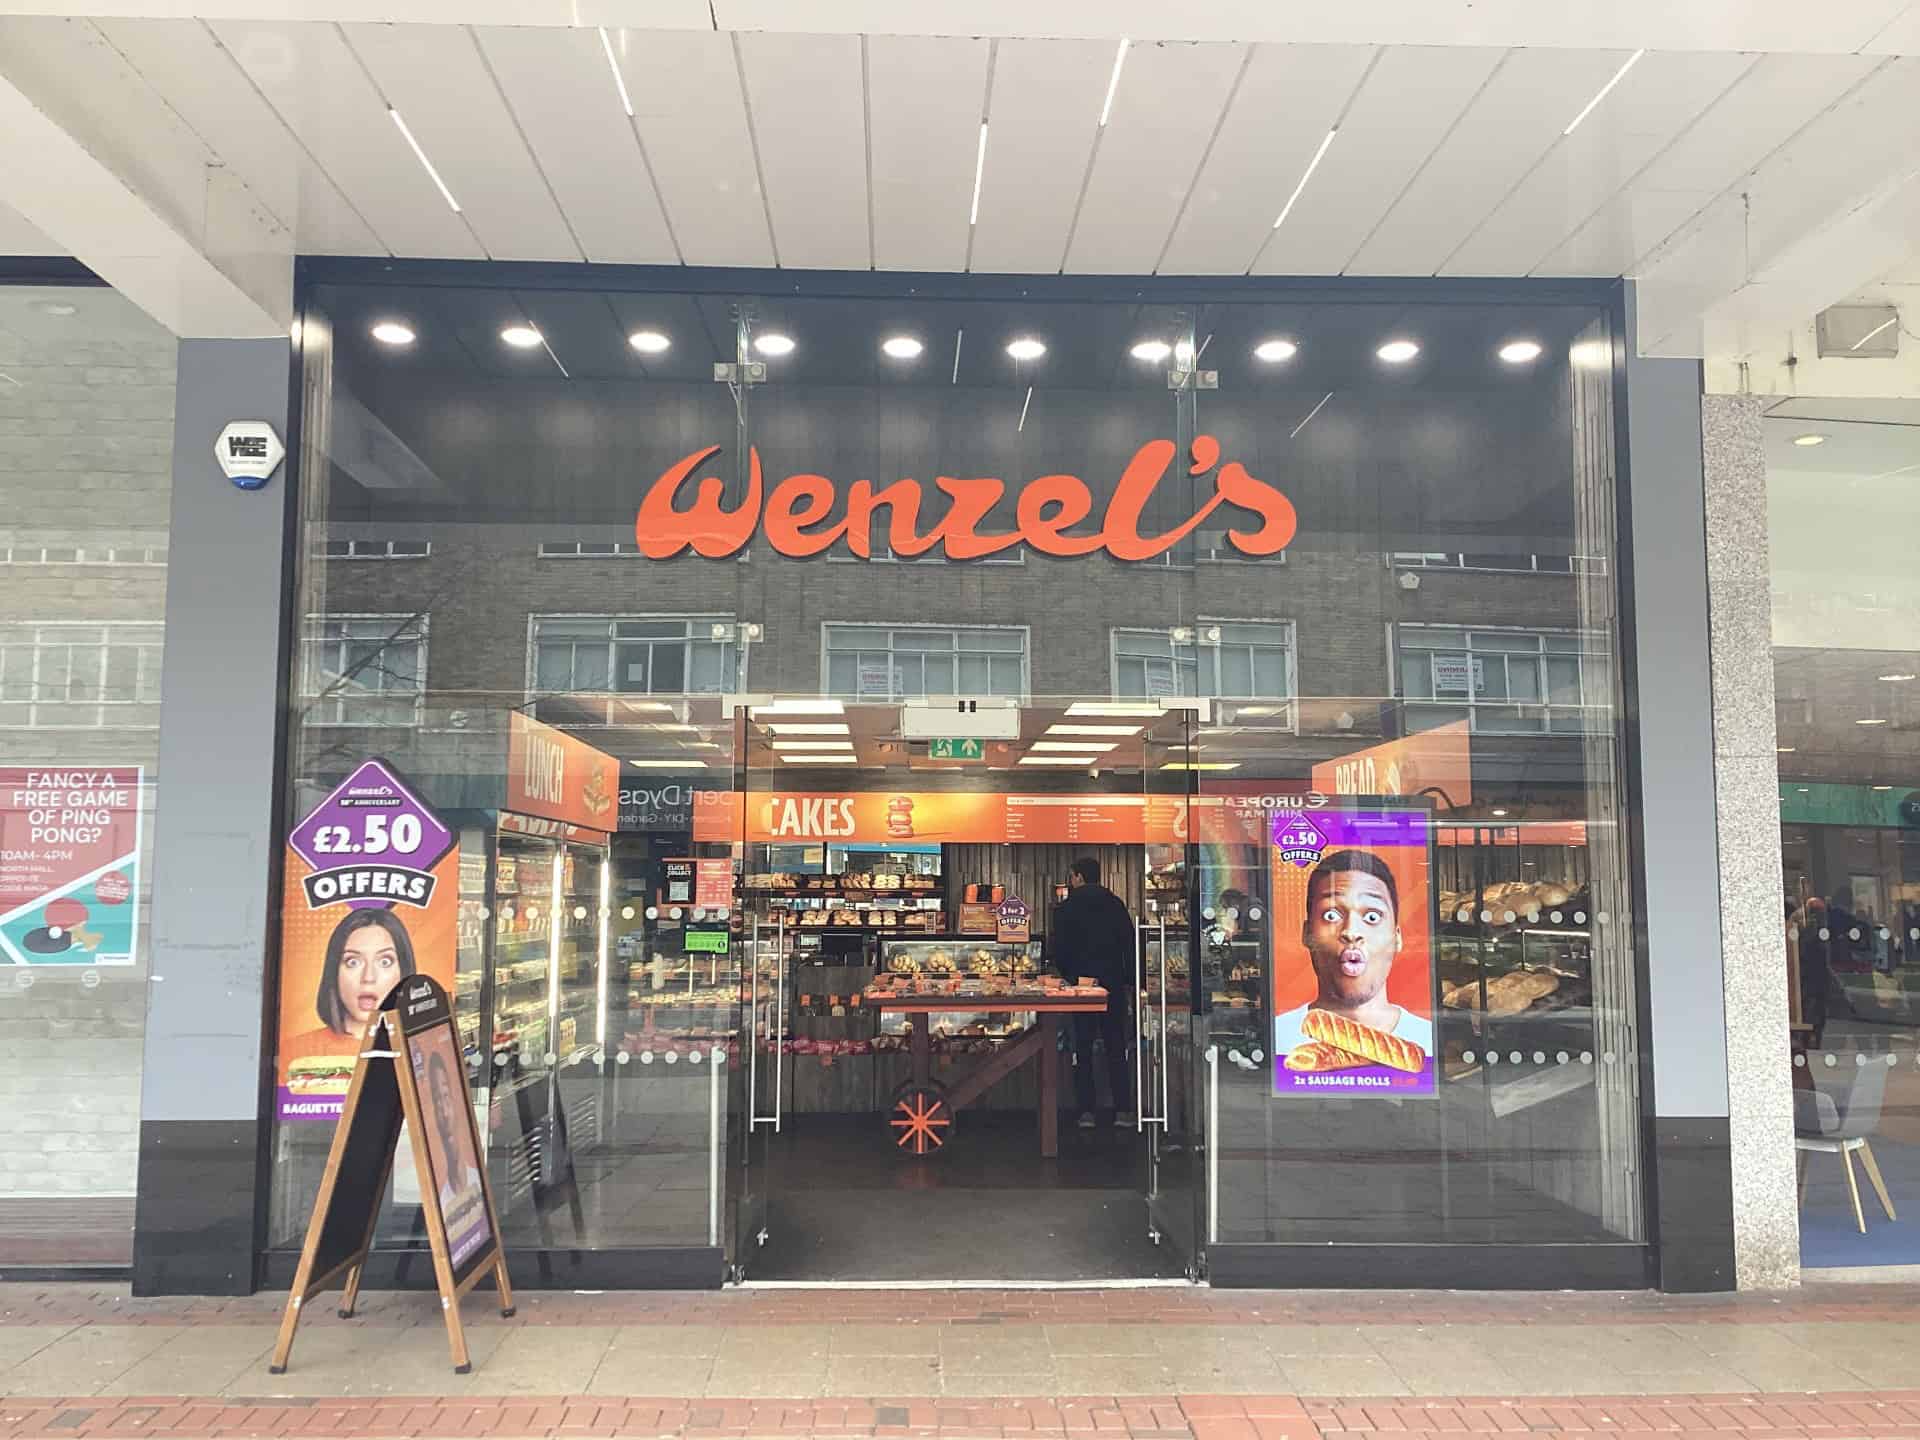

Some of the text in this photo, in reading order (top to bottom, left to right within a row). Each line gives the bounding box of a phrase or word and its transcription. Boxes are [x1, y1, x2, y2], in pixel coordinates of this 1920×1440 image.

[636, 435, 1297, 560] Wenzel's
[524, 735, 564, 804] LUNCH
[1335, 757, 1376, 795] BREAD
[27, 772, 117, 788] FANCY A
[13, 790, 128, 807] FREE GAME
[28, 809, 111, 825] OF PING
[761, 797, 856, 836] CAKES
[31, 827, 102, 844] PONG?
[313, 813, 422, 854] £2.50
[1282, 832, 1317, 846] £2.50
[1283, 851, 1318, 860] OFFERS
[314, 872, 427, 899] OFFERS
[1308, 1075, 1356, 1086] SAUSAGE
[1357, 1076, 1391, 1086] ROLLS
